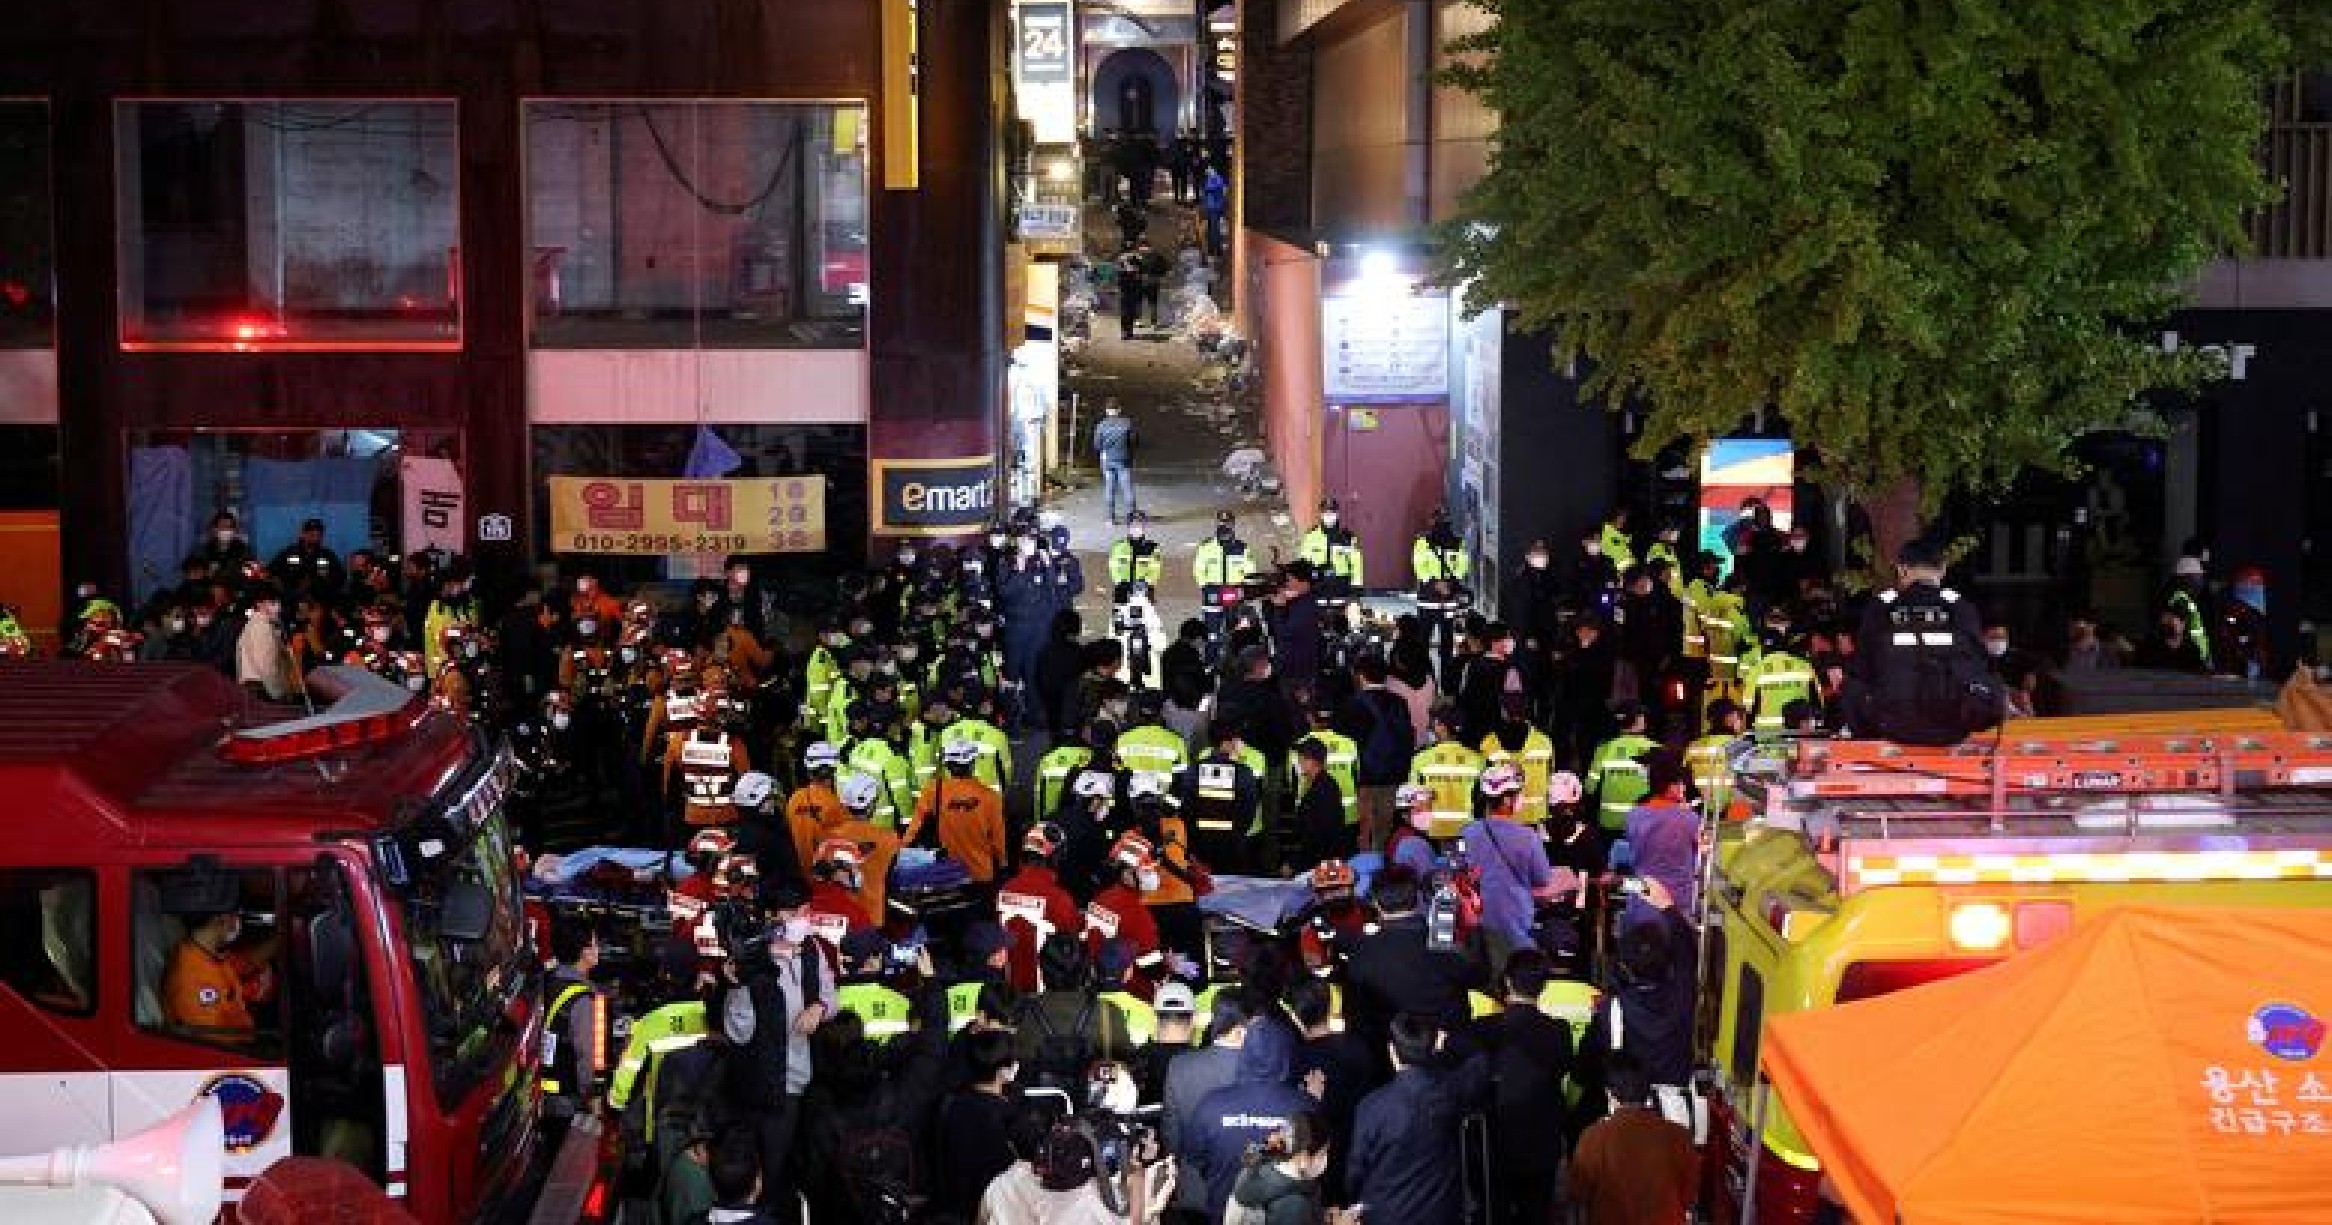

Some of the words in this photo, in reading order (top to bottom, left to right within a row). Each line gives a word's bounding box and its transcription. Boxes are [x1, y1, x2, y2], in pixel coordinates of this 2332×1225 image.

[1025, 29, 1064, 59] 24
[581, 483, 733, 531] 임대
[2200, 1066, 2279, 1105] 용산
